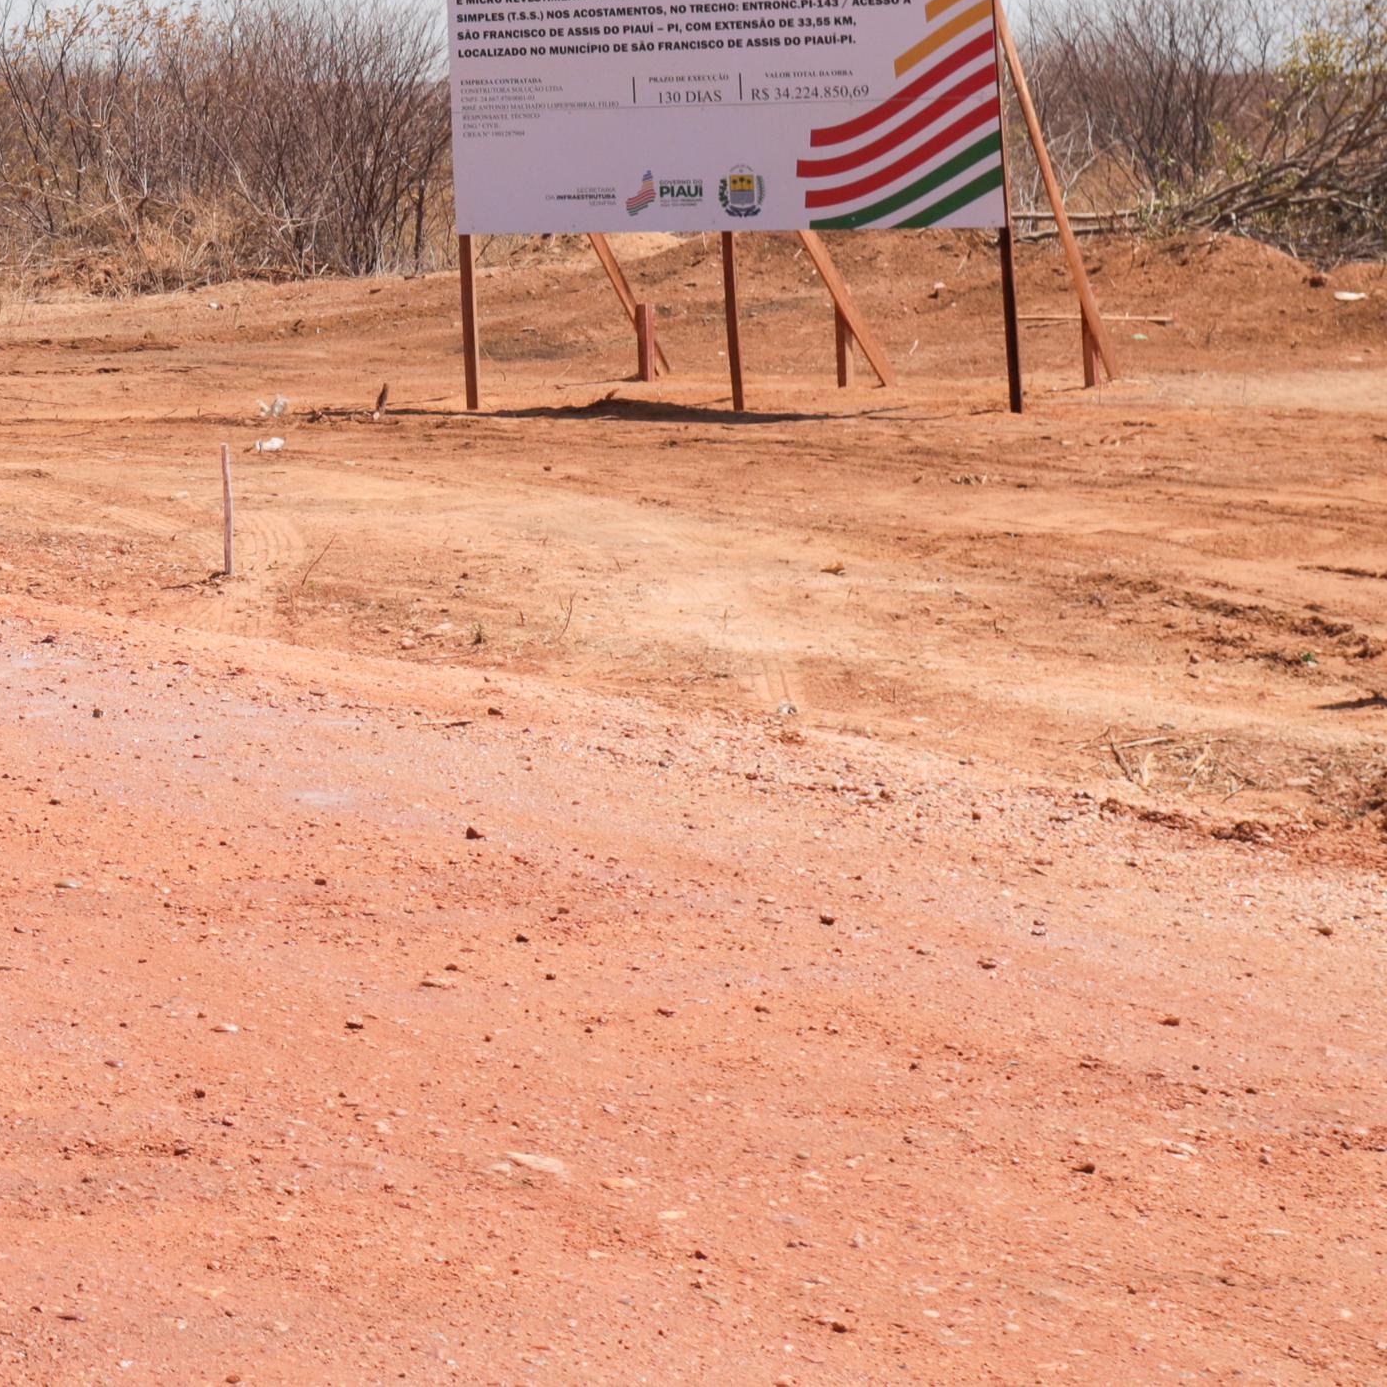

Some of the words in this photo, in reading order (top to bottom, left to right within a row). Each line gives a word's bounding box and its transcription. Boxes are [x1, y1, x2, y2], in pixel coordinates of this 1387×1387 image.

[457, 13, 505, 23] SIMPLES
[507, 11, 544, 22] (T.S.S.)
[547, 9, 570, 19] NOS
[573, 5, 667, 19] ACOSTAMENTOS,
[670, 4, 686, 14] NO
[689, 2, 739, 13] TRECHO:
[457, 29, 480, 41] SÃO
[483, 28, 546, 39] FRANCISCO
[549, 27, 565, 37] DE
[567, 25, 600, 37] ASSIS
[603, 25, 619, 35] DO
[623, 23, 654, 34] PIAUÍ
[667, 23, 682, 35] PI,
[685, 21, 711, 32] COM
[715, 17, 775, 30] EXTENSÃO
[779, 17, 794, 28] DE
[797, 16, 831, 28] 33,55
[834, 15, 857, 27] KM,
[458, 47, 527, 59] LOCALIZADO
[530, 45, 546, 55] NO
[549, 42, 609, 55] MUNICÍPIO
[613, 43, 628, 53] DE
[631, 40, 655, 52] SÃO
[658, 38, 724, 51] FRANCISCO
[727, 37, 743, 48] DE
[746, 37, 781, 47] ASSIS
[784, 36, 801, 46] DO
[805, 33, 856, 45] PIAUÍ-PI.
[675, 75, 685, 83] DE
[687, 73, 729, 83] EXECUÇÃO
[765, 71, 791, 79] VALOR
[831, 69, 853, 77] OBRA
[659, 91, 681, 104] 130
[685, 89, 723, 103] DIAS
[751, 87, 769, 101] R$
[773, 85, 869, 101] 34.224.850,69
